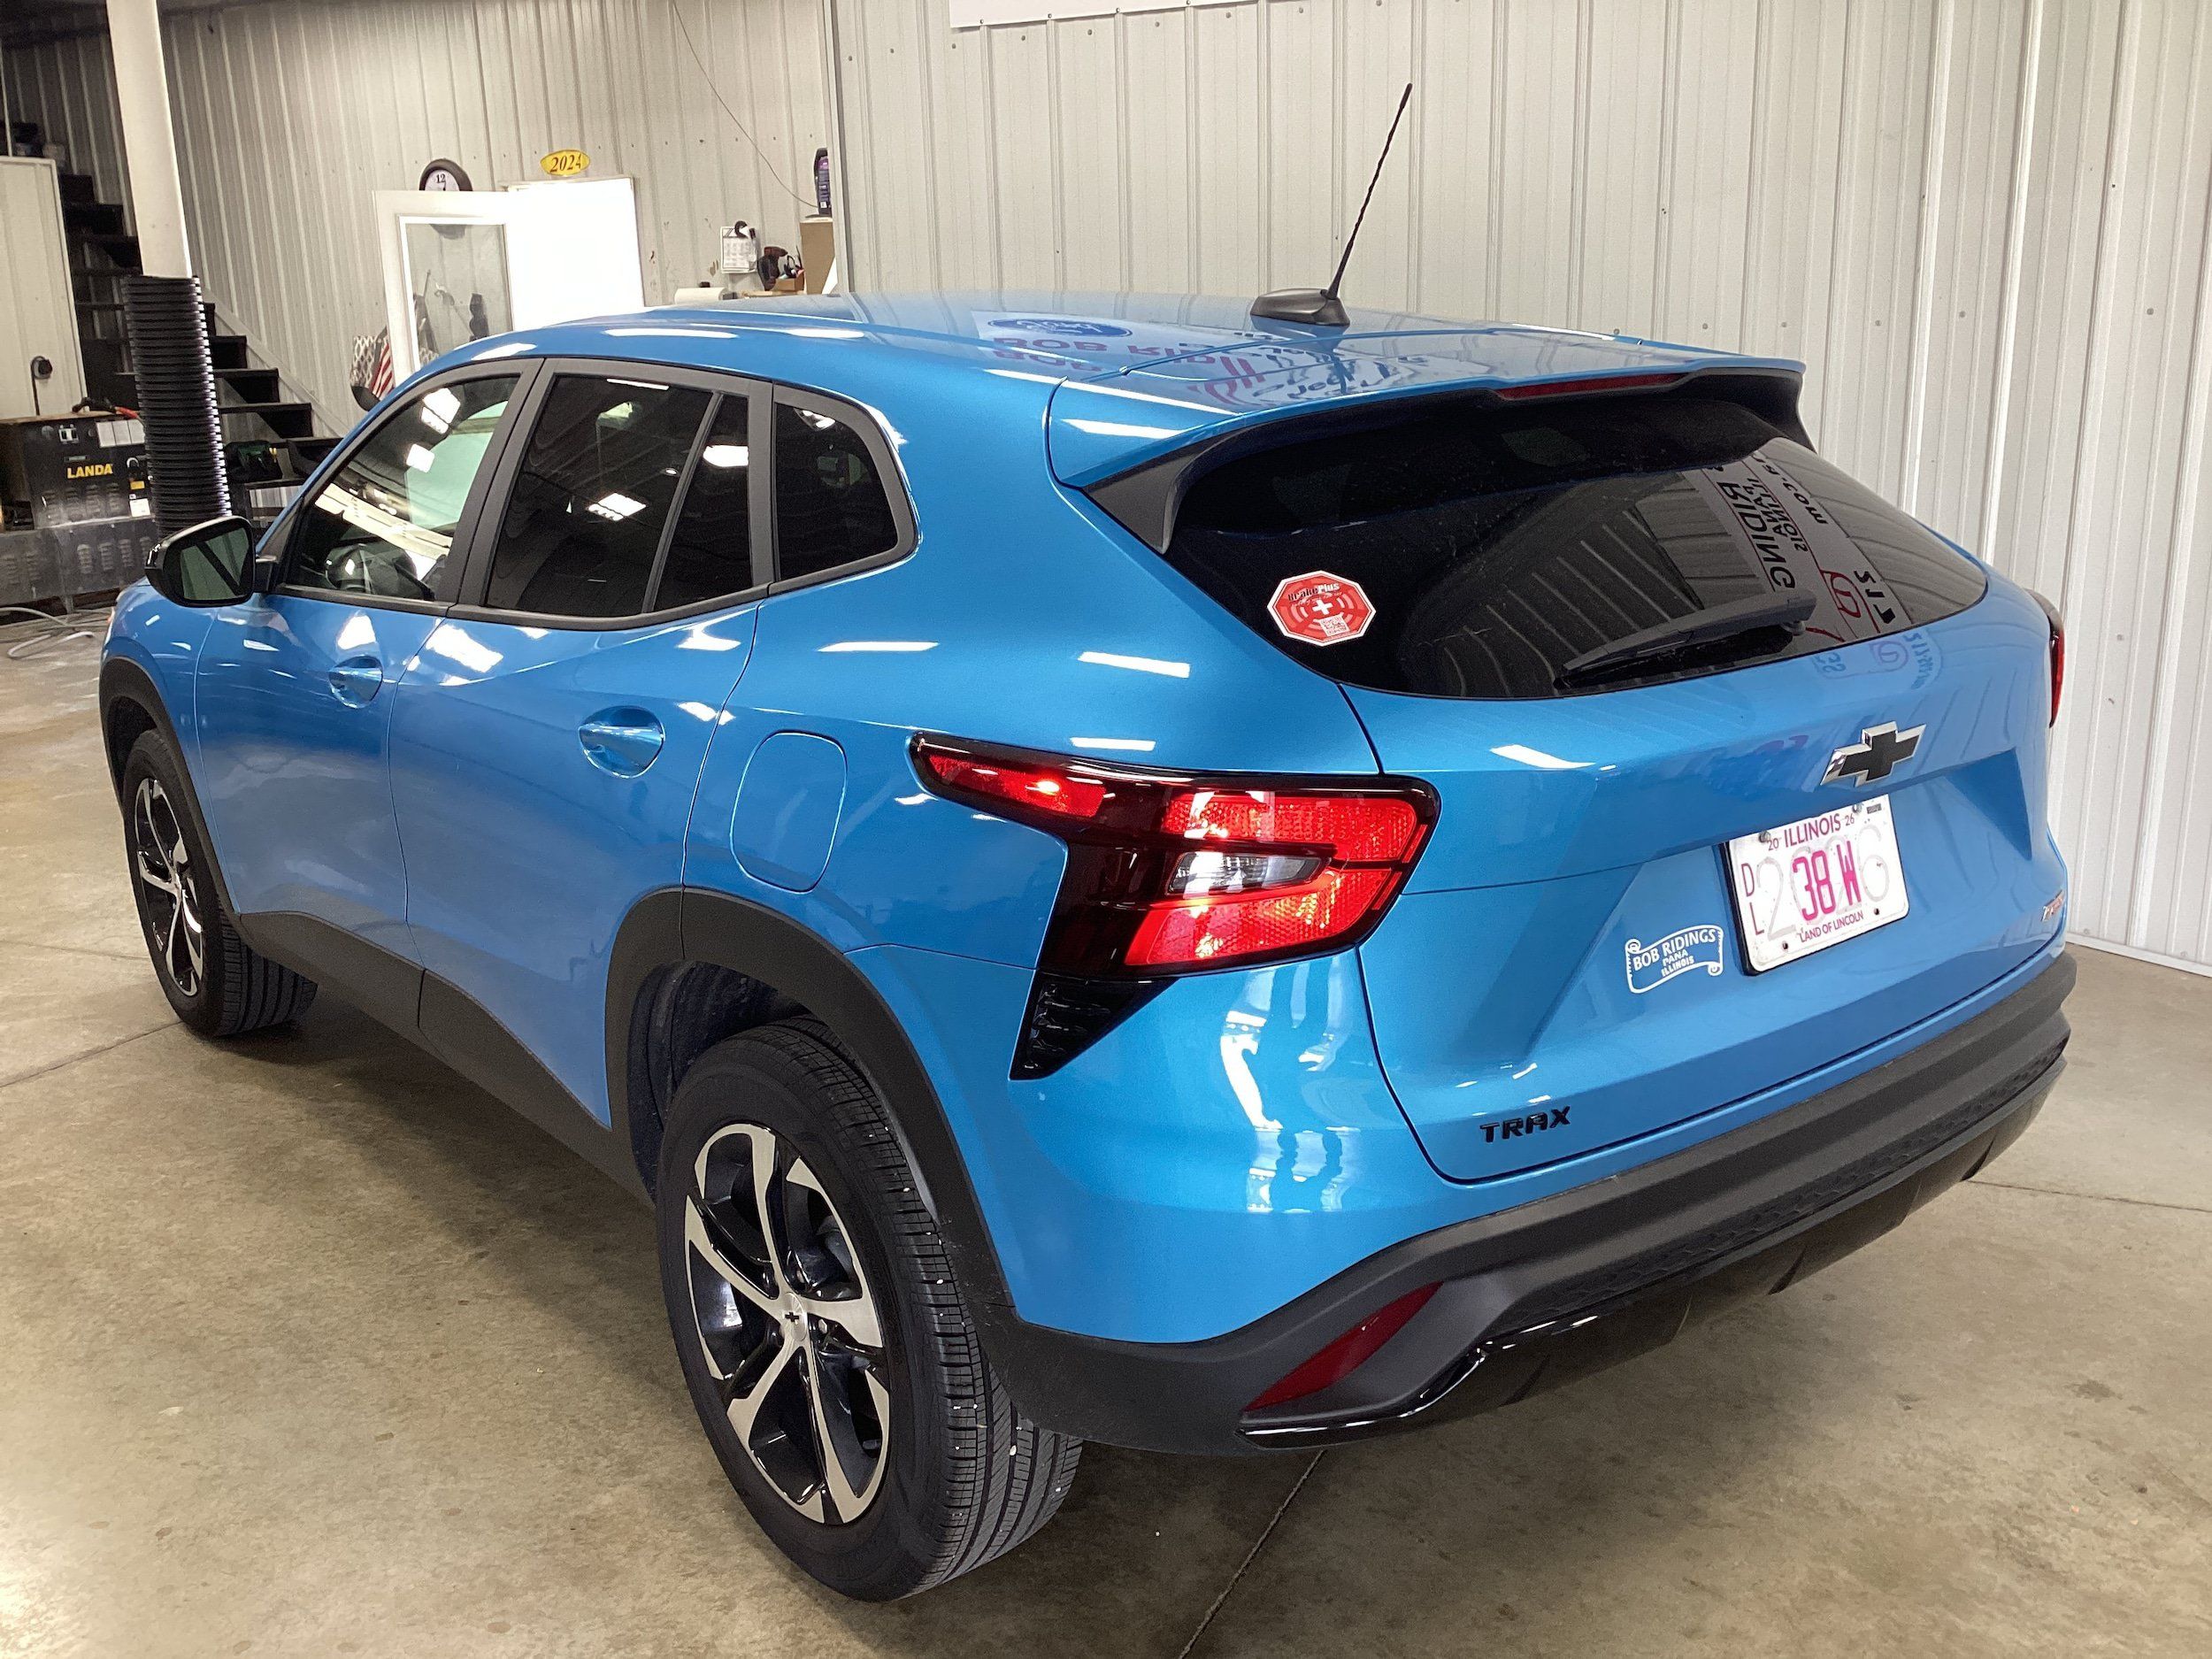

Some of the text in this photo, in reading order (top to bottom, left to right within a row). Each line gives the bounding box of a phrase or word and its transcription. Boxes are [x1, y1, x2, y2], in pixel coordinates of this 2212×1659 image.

[436, 173, 446, 183] 12
[67, 464, 113, 479] LANDA
[1784, 813, 1841, 848] ILLINOIS
[1845, 814, 1855, 826] 26
[1799, 910, 1864, 943] LAND OF LINCOLN
[1632, 929, 1717, 971] BOB RIDINGS
[1661, 956, 1694, 977] ILLINOIS
[1479, 1106, 1571, 1142] TRAX
